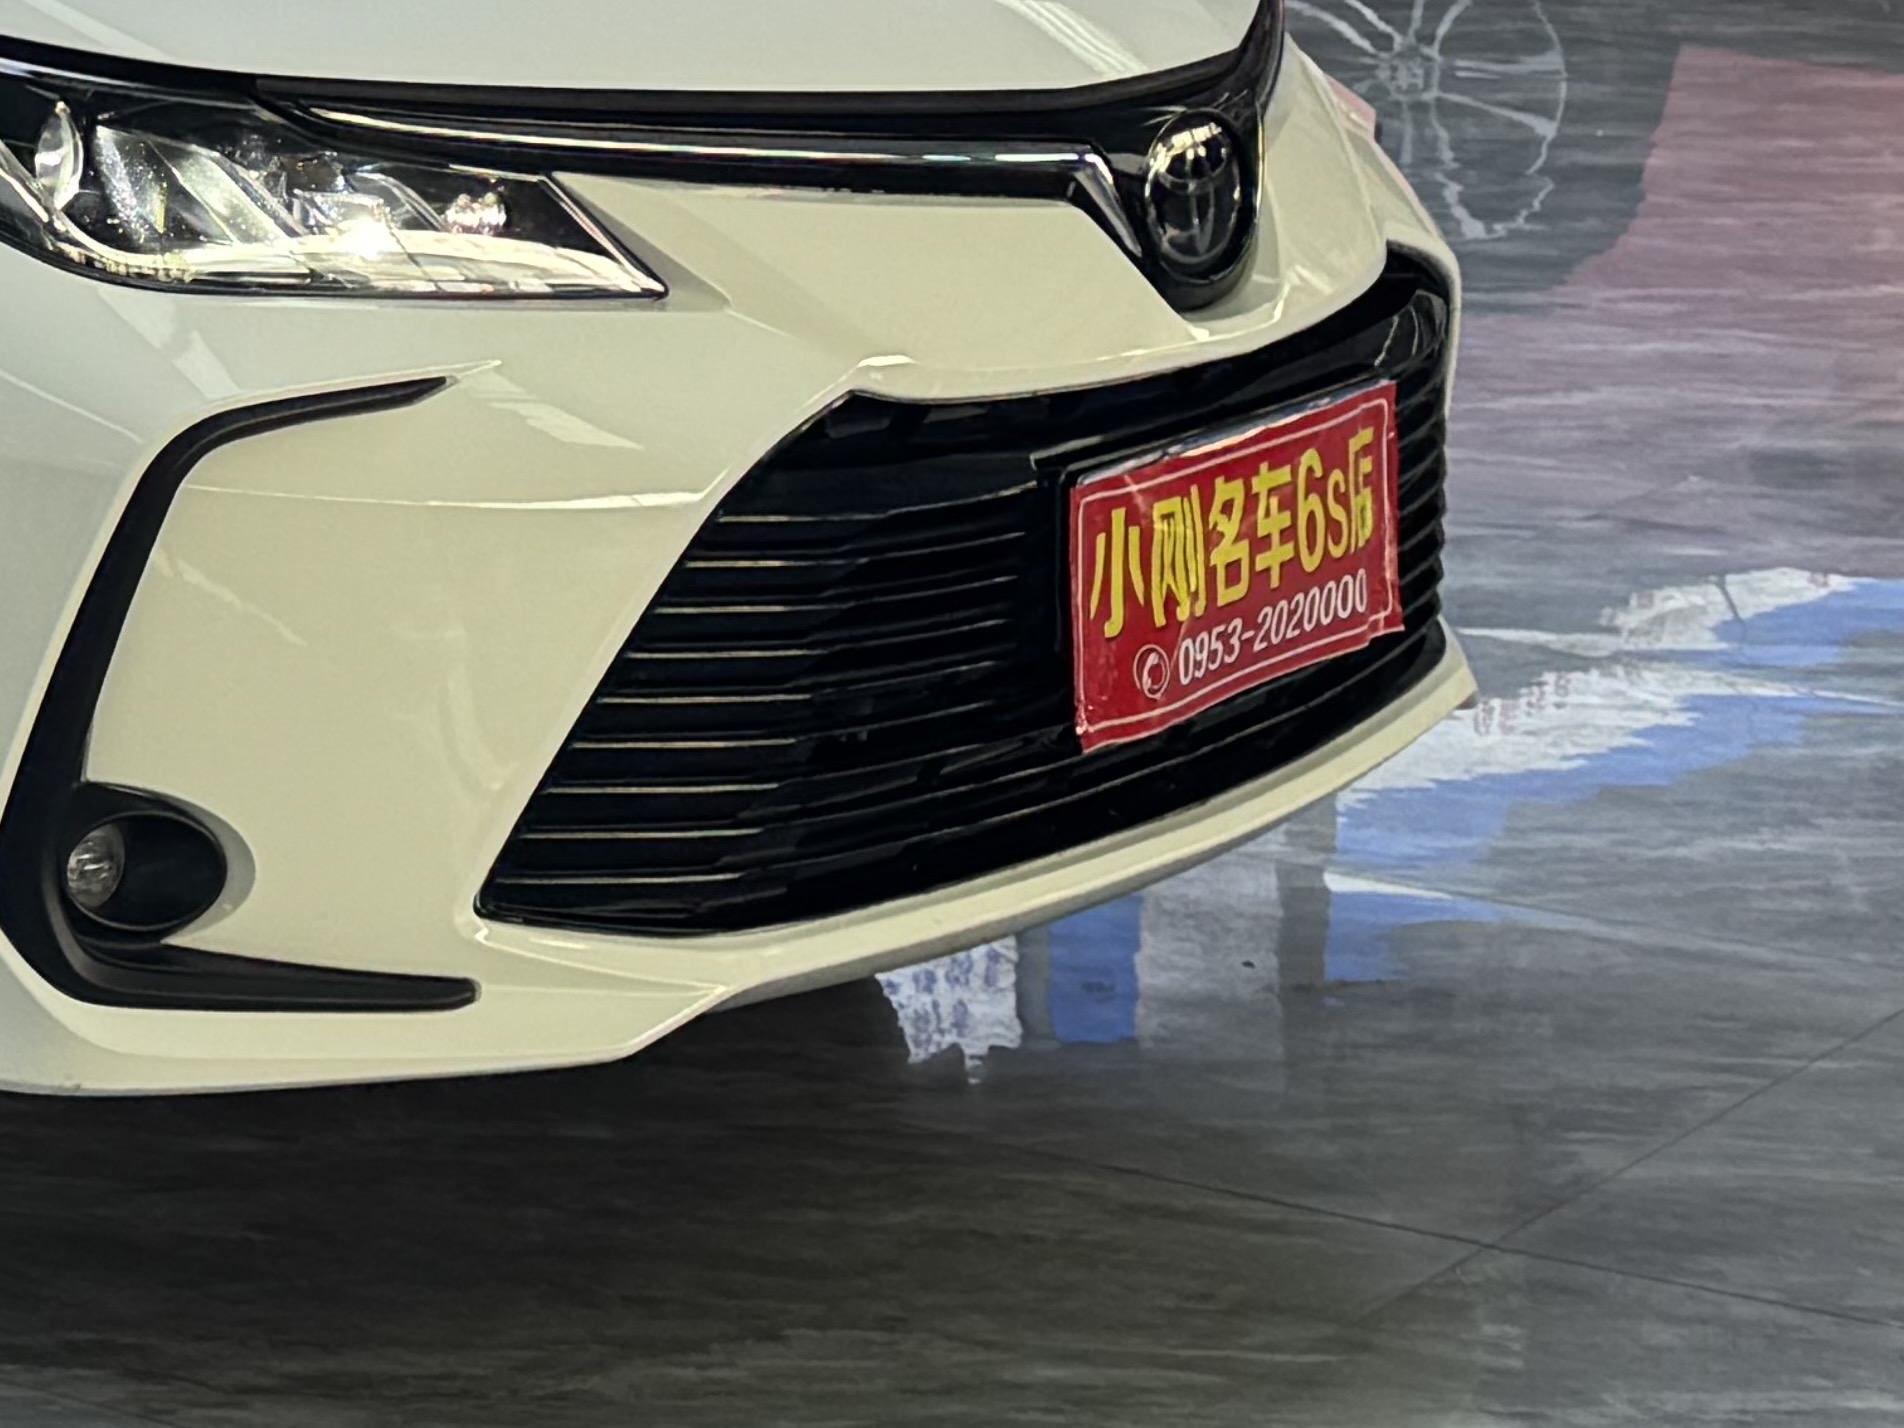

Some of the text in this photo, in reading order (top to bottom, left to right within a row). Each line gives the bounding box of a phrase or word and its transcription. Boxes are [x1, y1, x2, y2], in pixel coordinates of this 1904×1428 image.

[1089, 426, 1375, 639] 小刚名车6s店
[1177, 567, 1370, 686] 0953-2020000
